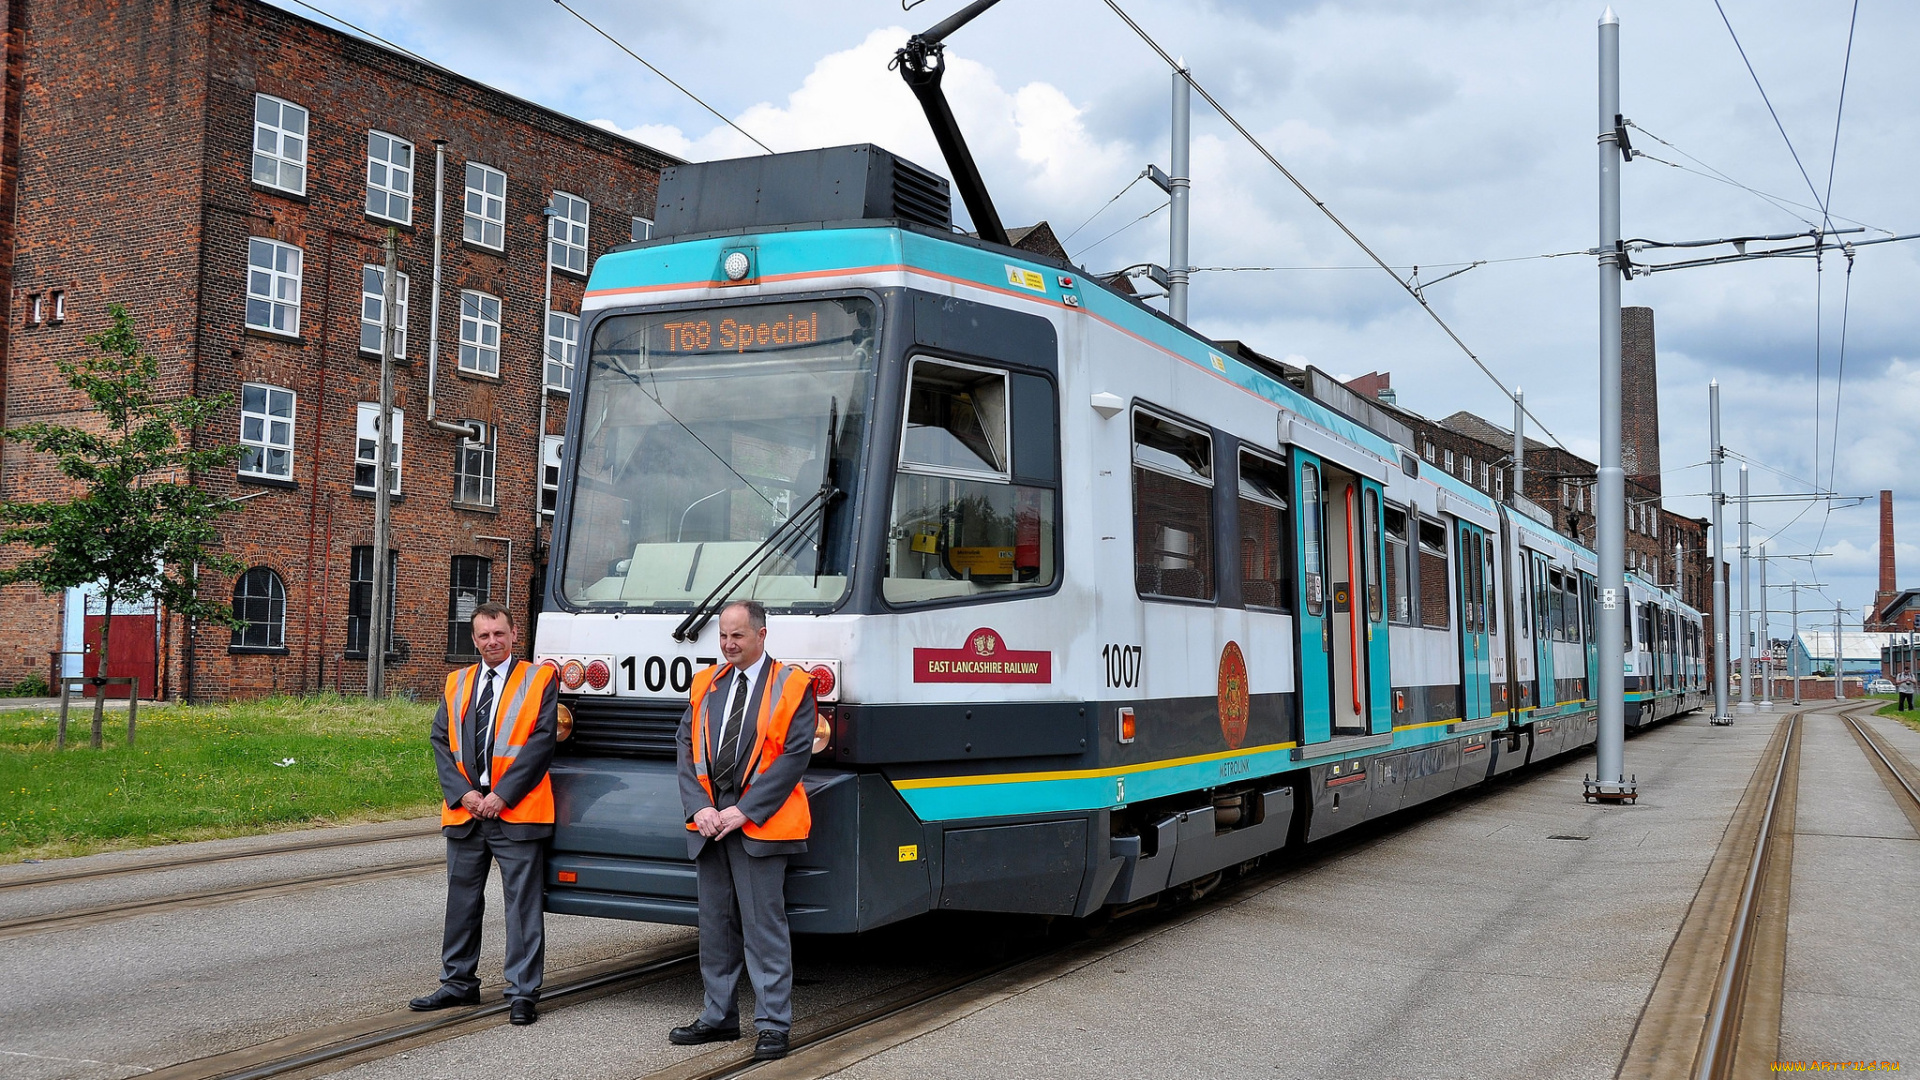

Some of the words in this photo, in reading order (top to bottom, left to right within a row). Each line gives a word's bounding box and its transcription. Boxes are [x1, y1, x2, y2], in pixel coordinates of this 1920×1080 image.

[664, 320, 711, 351] T68
[719, 312, 817, 353] Special
[928, 660, 950, 673] EAST
[951, 661, 1002, 674] LANCASHIRE
[1004, 662, 1039, 674] RAILWAY
[1102, 643, 1142, 688] 1007
[1219, 758, 1250, 778] METROLINK
